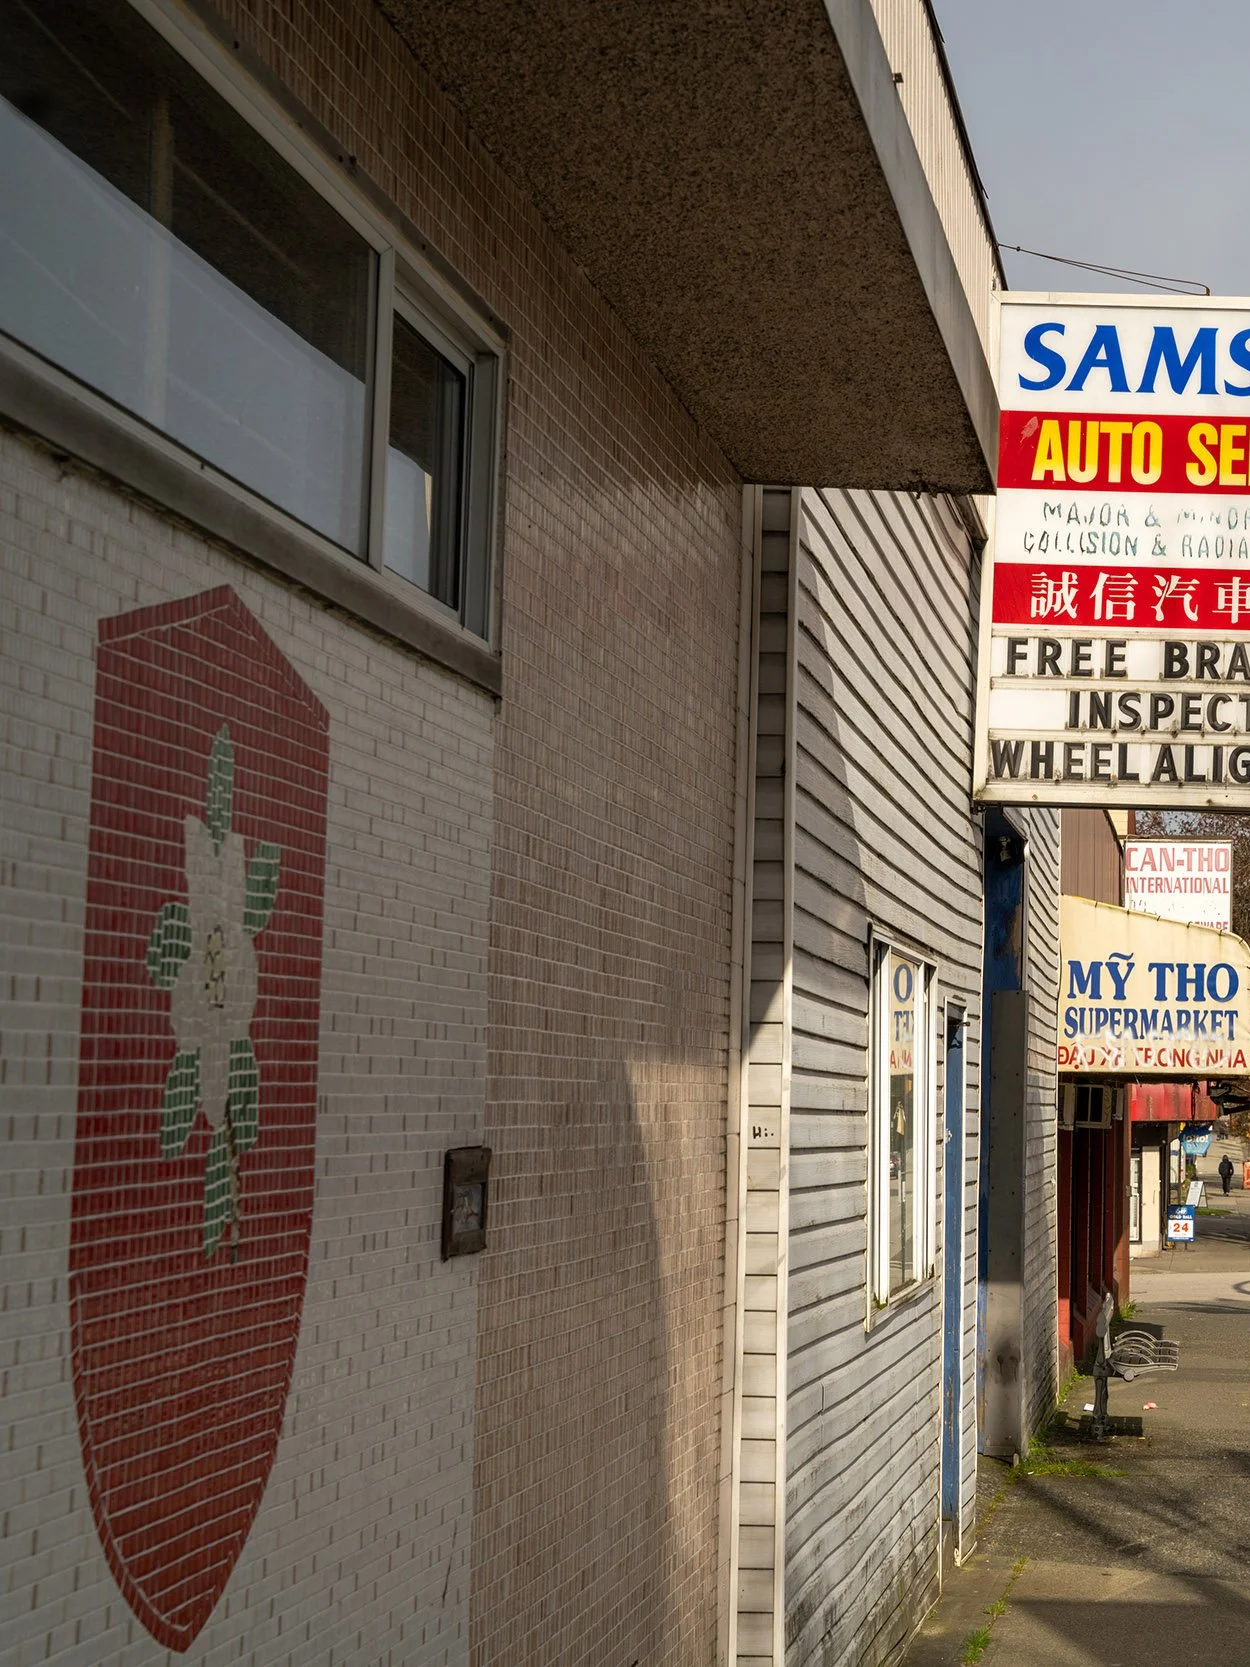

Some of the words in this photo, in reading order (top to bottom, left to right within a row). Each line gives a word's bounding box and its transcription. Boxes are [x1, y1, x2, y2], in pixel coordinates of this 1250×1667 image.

[1031, 420, 1163, 485] AUTO
[1151, 534, 1166, 556] &
[1006, 637, 1127, 678] FREE
[1126, 847, 1229, 872] CAN-THO
[1126, 877, 1229, 894] INTERNATIONAL
[1067, 952, 1135, 1001] MỸ
[1148, 962, 1240, 1003] THO
[1064, 1006, 1239, 1041] SUPERMARKET
[1173, 1222, 1189, 1232] 24
